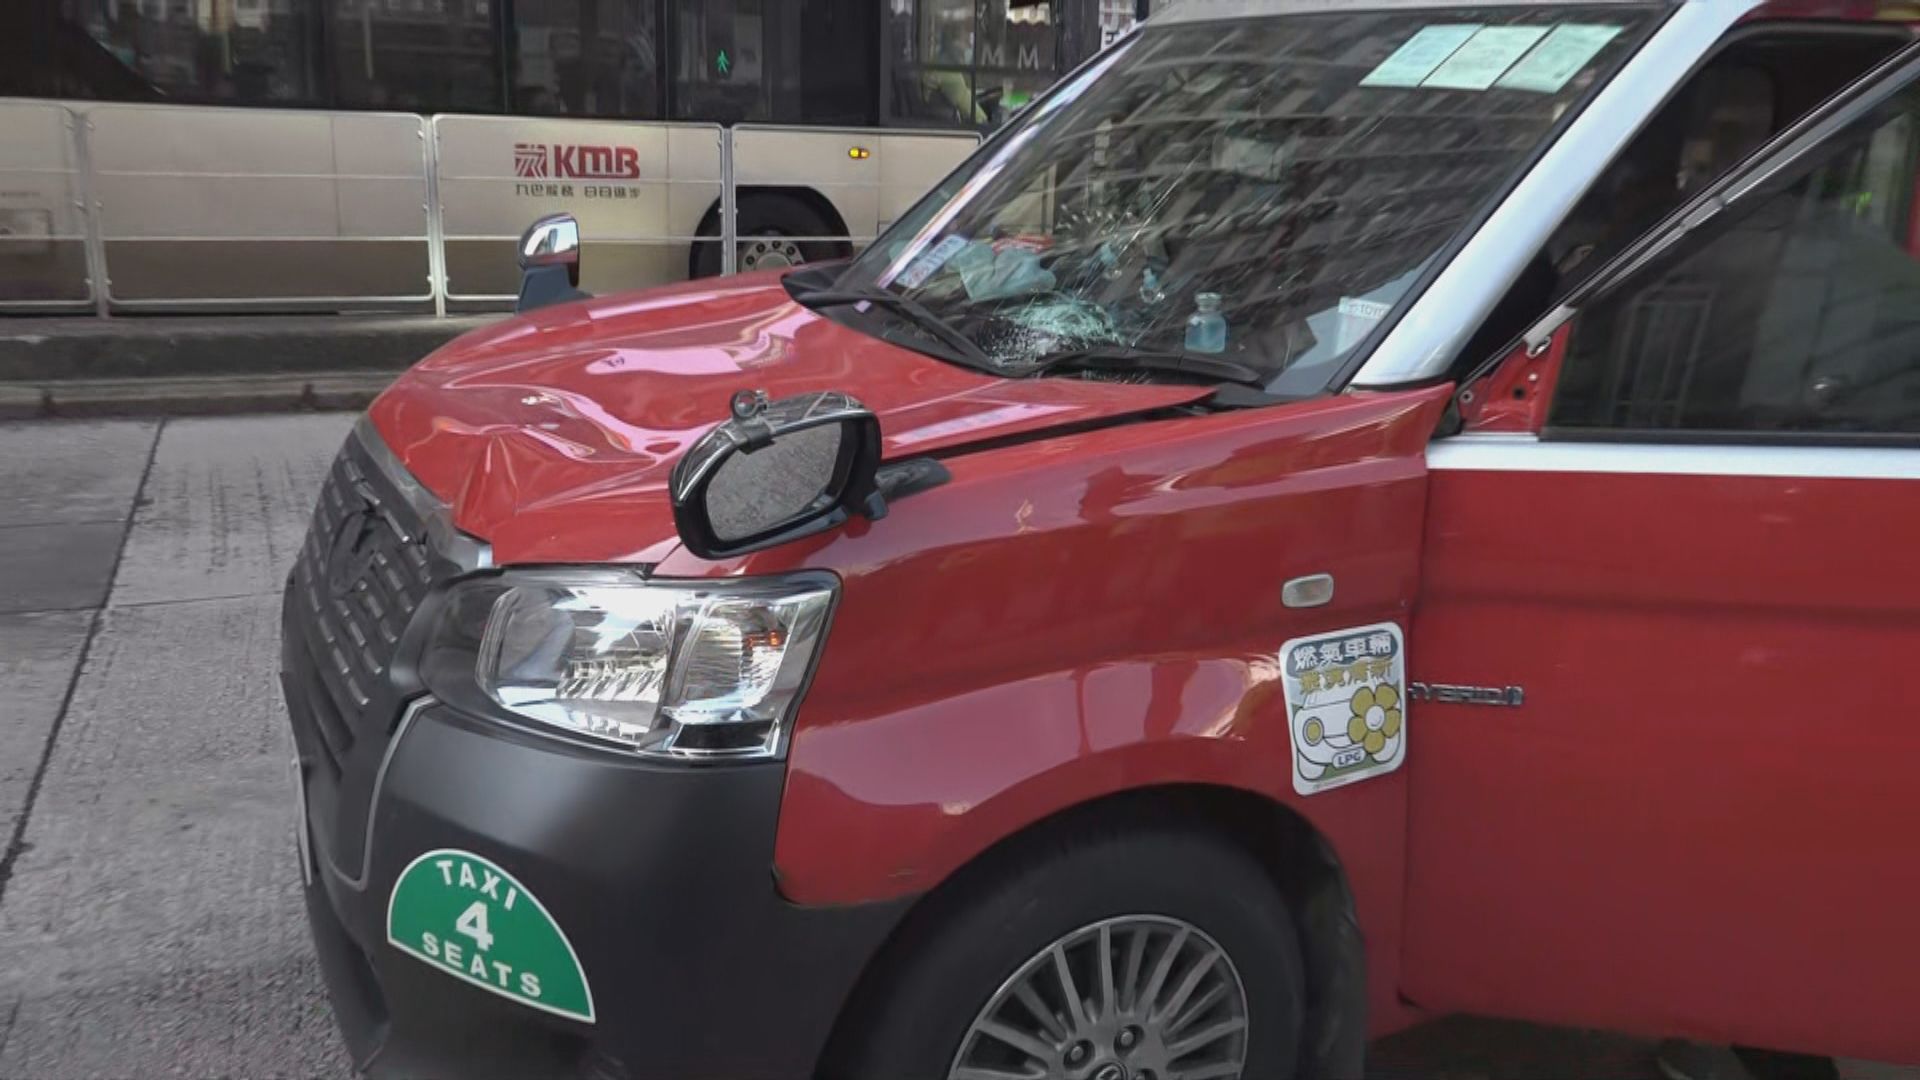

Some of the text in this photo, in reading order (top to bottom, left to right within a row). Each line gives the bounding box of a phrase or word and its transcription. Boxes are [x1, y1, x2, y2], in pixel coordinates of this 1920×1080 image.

[553, 143, 641, 179] KMB
[1293, 633, 1392, 671] 燃氣車輛
[1338, 752, 1361, 766] LPG
[436, 859, 518, 911] TAXI
[455, 900, 494, 951] 4
[422, 931, 542, 998] SEATS
